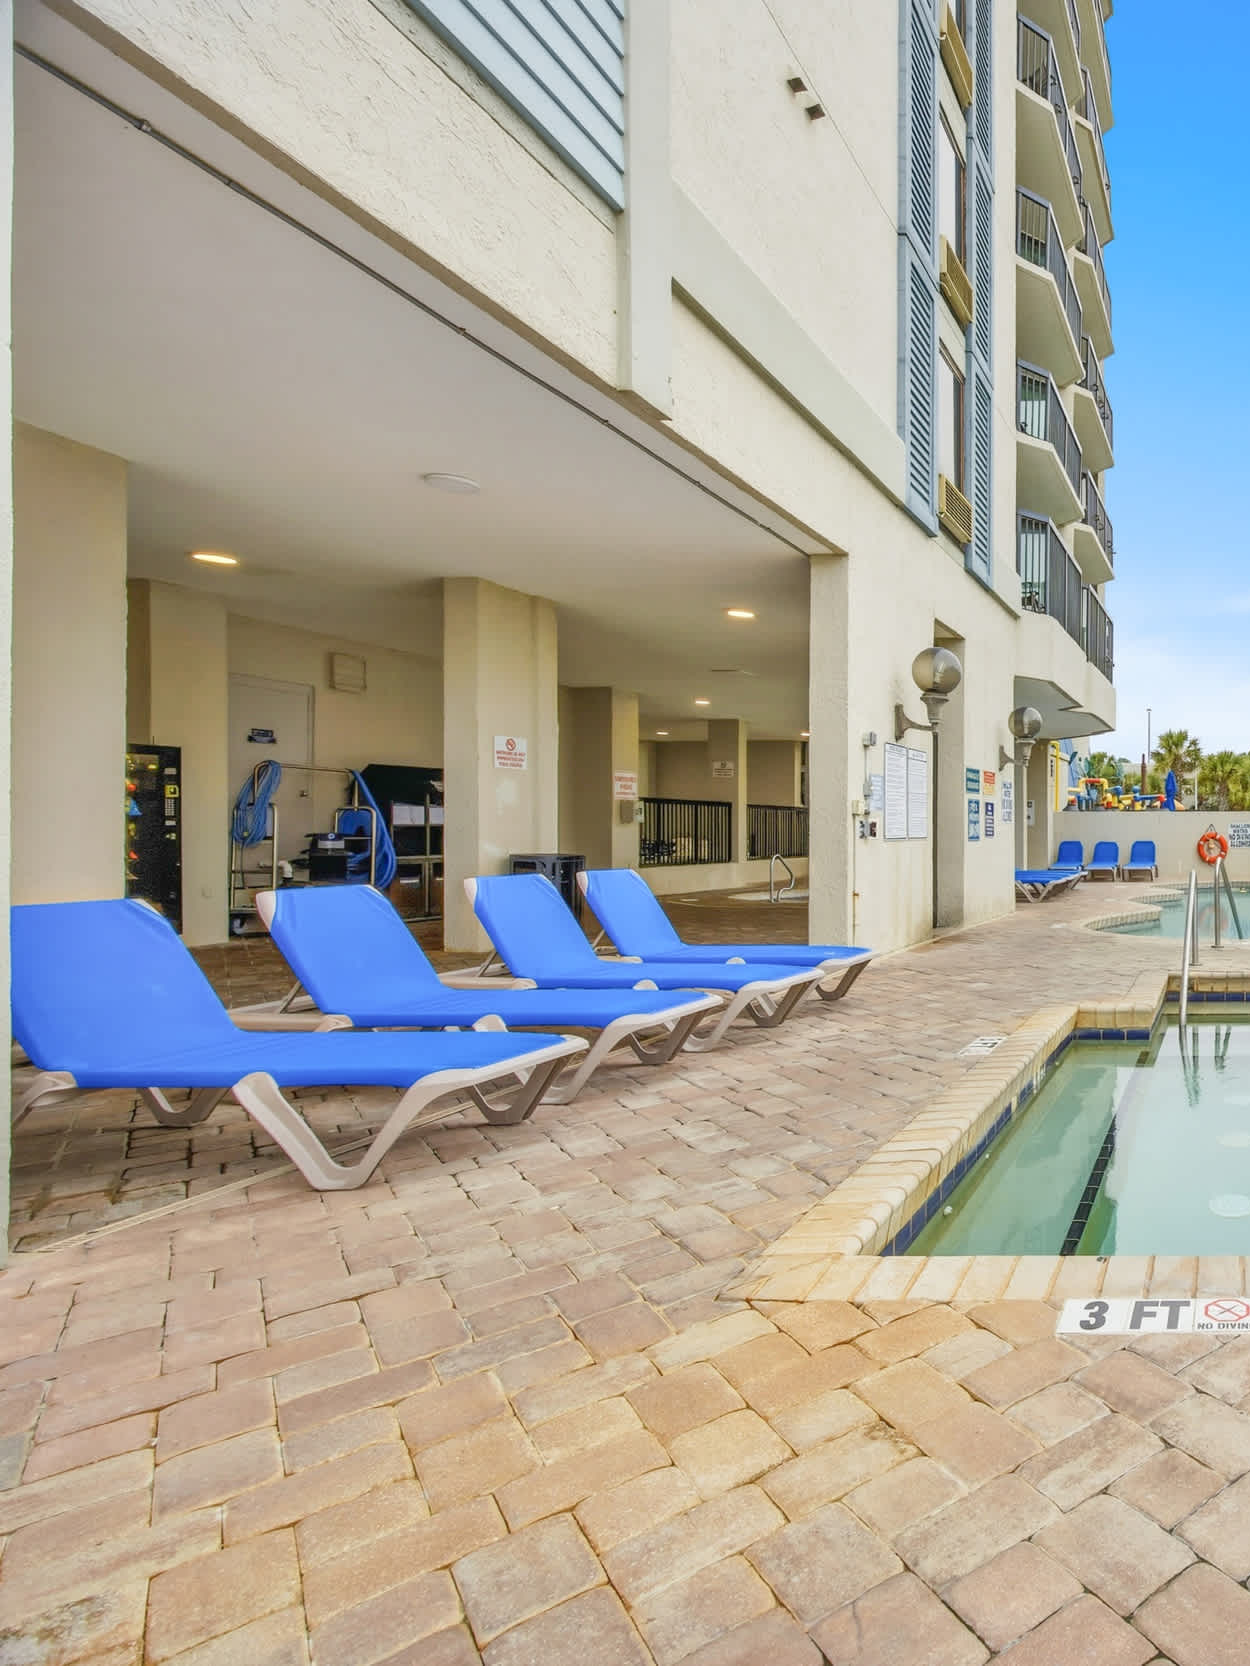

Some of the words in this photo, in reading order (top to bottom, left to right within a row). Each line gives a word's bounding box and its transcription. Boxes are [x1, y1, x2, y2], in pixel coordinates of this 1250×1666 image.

[1079, 1300, 1109, 1330] 3
[1129, 1300, 1191, 1330] FT
[1197, 1322, 1213, 1330] NO
